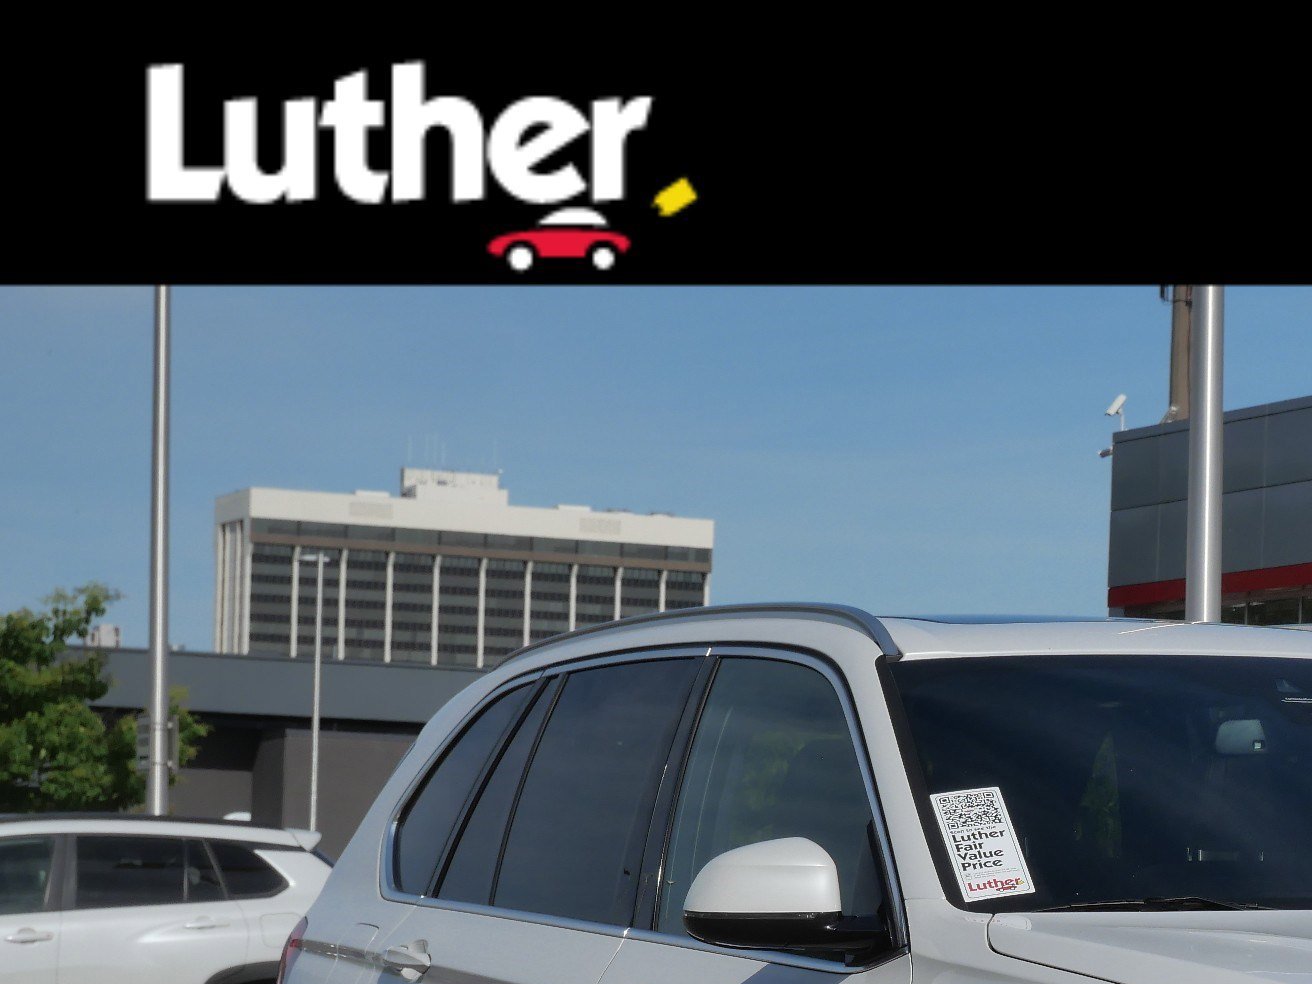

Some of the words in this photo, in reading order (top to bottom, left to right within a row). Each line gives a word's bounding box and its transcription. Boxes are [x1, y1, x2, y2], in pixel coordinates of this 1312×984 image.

[952, 830, 1006, 844] Luther
[954, 841, 984, 853] Fair
[957, 849, 1005, 861] Value
[961, 859, 1004, 872] Price
[967, 877, 1022, 892] Luther
